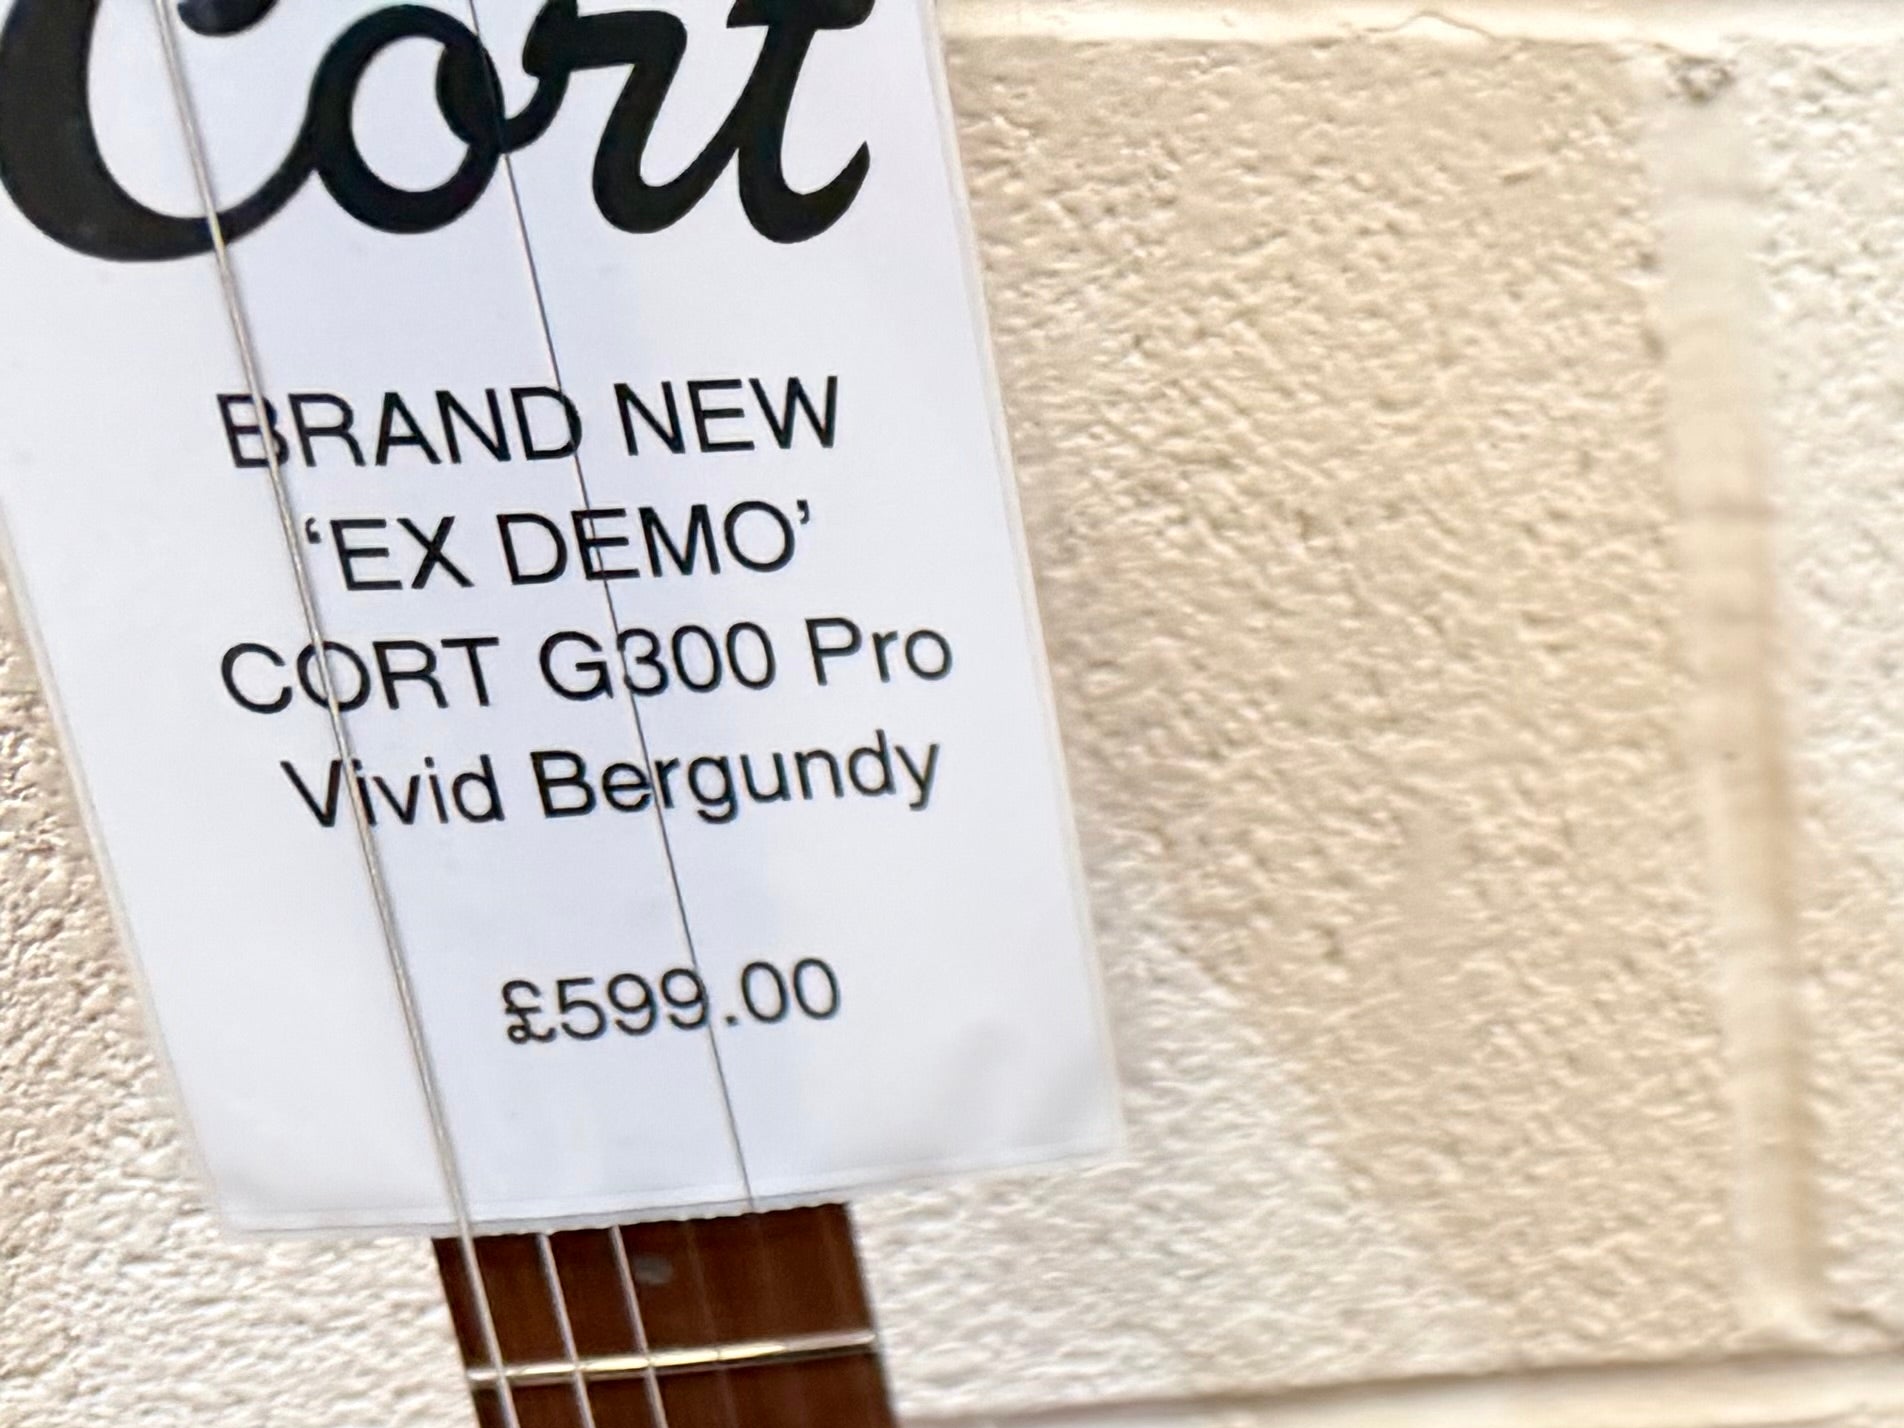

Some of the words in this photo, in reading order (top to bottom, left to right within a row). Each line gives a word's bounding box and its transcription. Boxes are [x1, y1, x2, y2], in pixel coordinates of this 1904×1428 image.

[0, 0, 875, 263] Cort
[215, 385, 584, 469] BRAND
[613, 375, 839, 456] NEW
[219, 635, 500, 715] CORT
[539, 621, 777, 702] G300
[805, 616, 954, 687] Pro
[280, 753, 506, 830] Vivid
[530, 728, 941, 827] Bergundy
[502, 956, 841, 1048] £599.00
